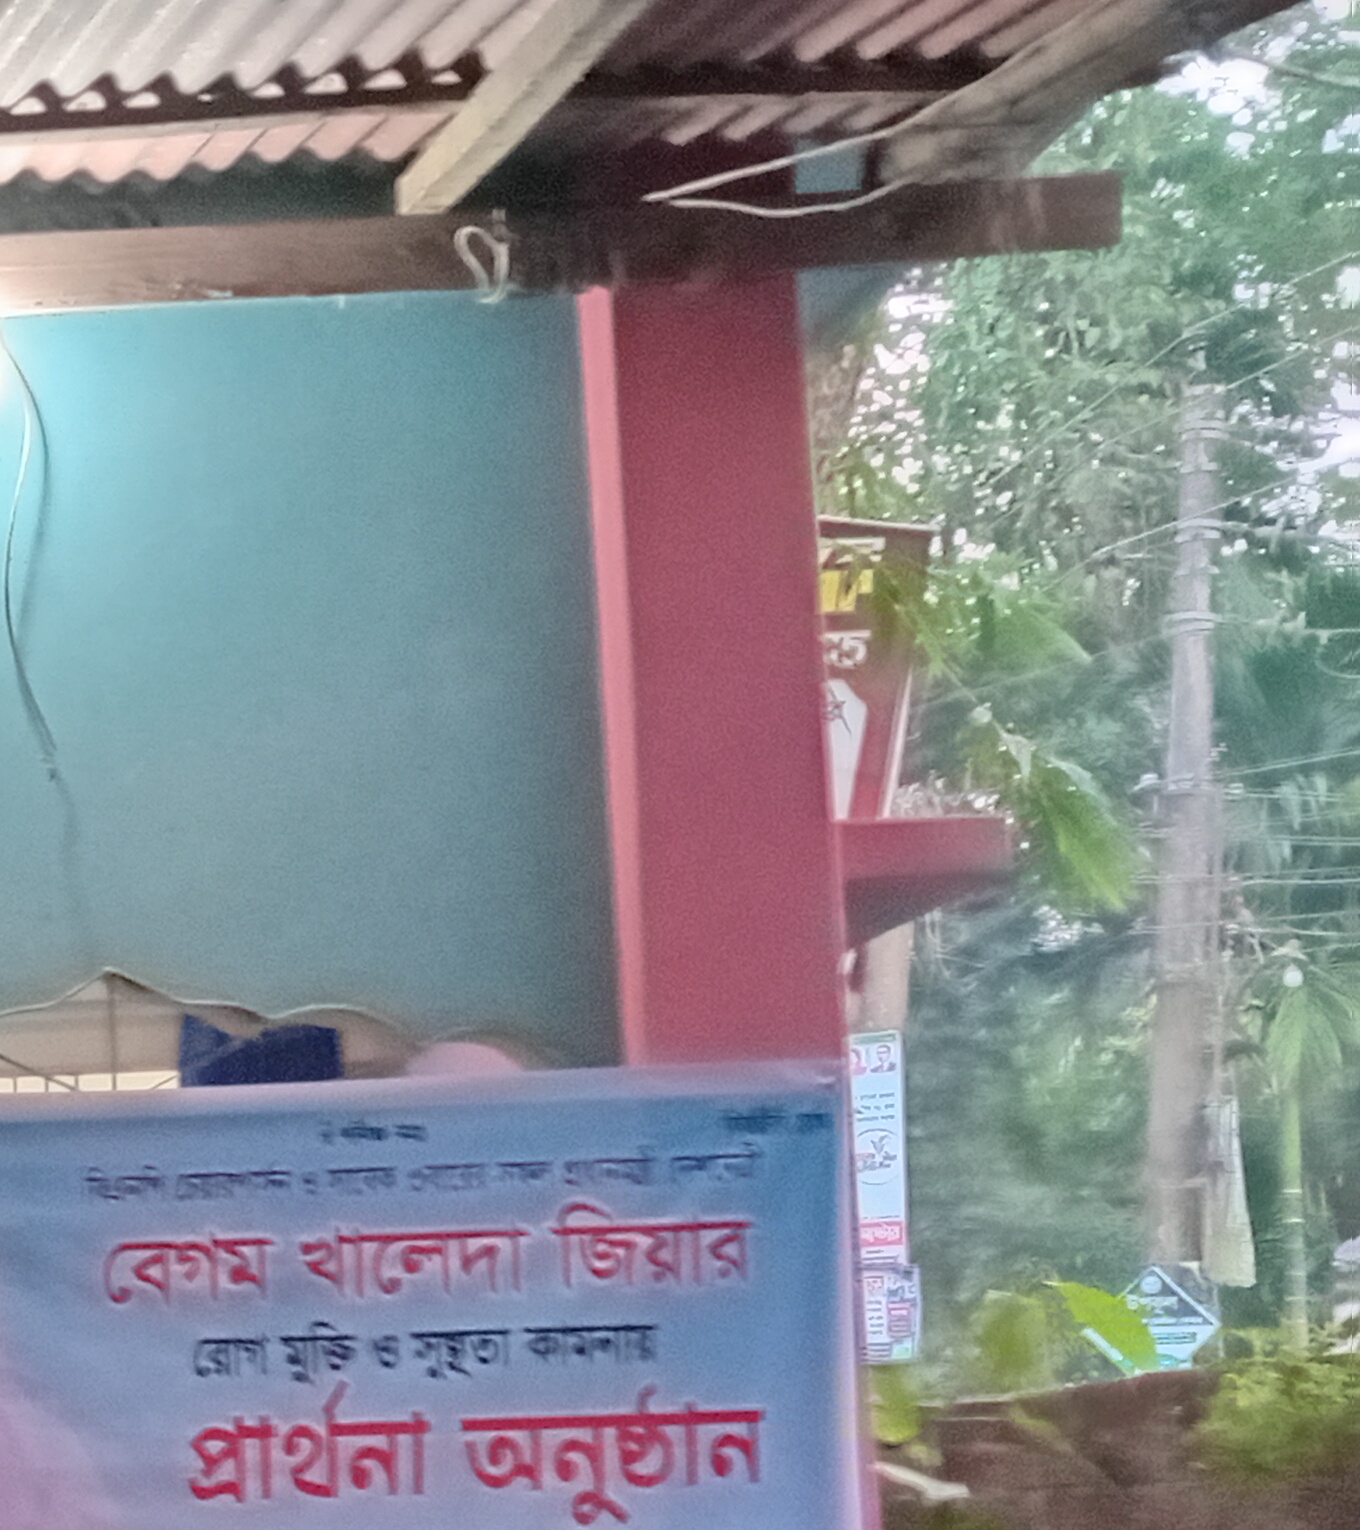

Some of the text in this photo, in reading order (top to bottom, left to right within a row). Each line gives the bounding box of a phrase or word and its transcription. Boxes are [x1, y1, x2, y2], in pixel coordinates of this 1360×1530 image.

[103, 1200, 752, 1305] বেগম খালেদা জিয়ার
[192, 1337, 270, 1378] রোগ
[279, 1321, 358, 1382] মুক্তি
[372, 1334, 402, 1369] ও
[523, 1324, 658, 1363] কামনায়
[189, 1380, 767, 1527] প্রার্থনা অনুষ্ঠান
